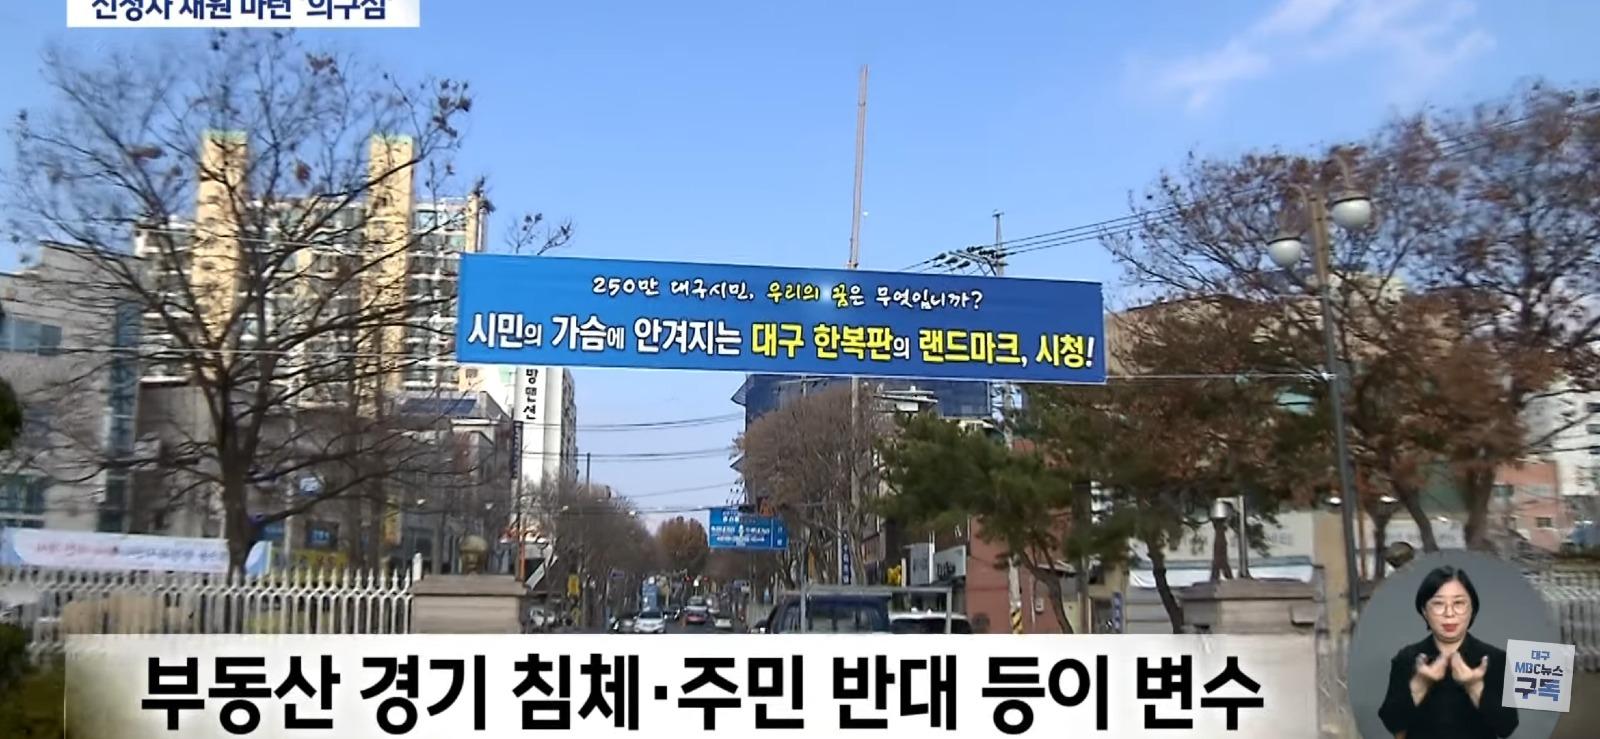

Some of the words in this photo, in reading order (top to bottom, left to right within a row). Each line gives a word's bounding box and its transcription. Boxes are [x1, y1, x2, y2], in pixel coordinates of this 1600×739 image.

[592, 277, 659, 296] 250만
[671, 278, 754, 300] 대구시민,
[767, 281, 819, 303] 우리의
[832, 283, 865, 308] 꿈은
[876, 286, 983, 310] 무엇입니까?
[468, 312, 542, 348] 시민의
[552, 315, 625, 351] 가슴에
[634, 317, 742, 355] 안겨지는
[752, 323, 804, 357] 대구
[813, 323, 910, 360] 한복판의
[919, 329, 1028, 368] 랜드마크,
[1036, 334, 1095, 368] 시청!
